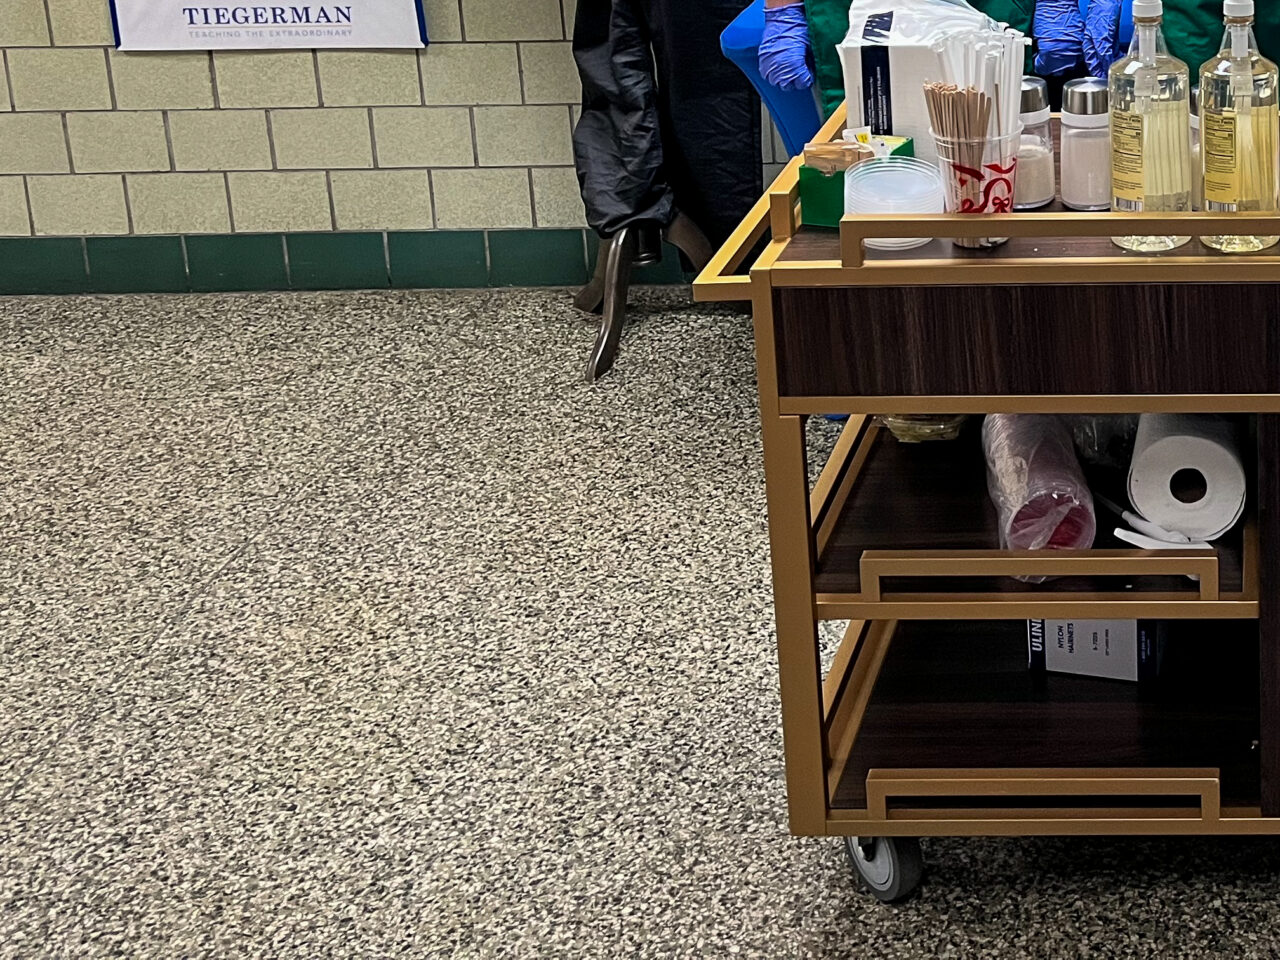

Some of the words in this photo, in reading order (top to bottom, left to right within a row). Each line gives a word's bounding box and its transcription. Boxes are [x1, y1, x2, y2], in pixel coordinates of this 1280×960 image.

[182, 6, 352, 25] TIEGERMAN
[189, 30, 240, 38] TEACHING
[270, 29, 352, 38] EXTRAORDINARY
